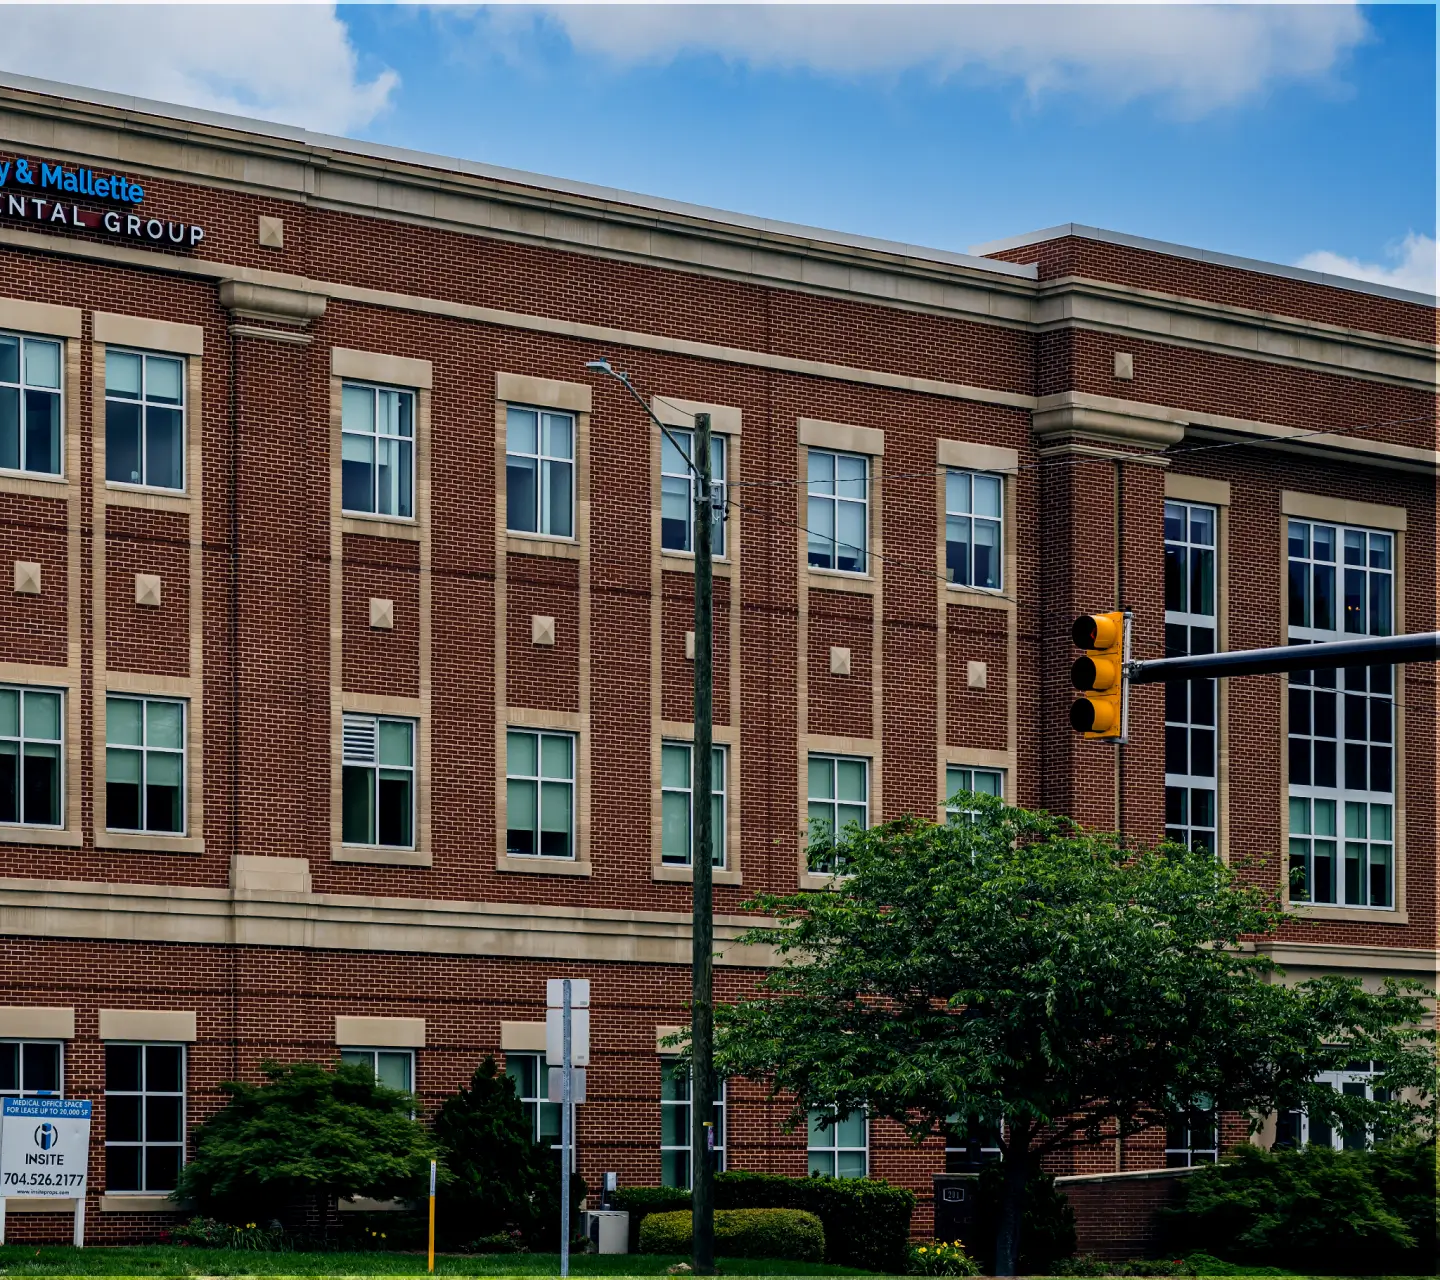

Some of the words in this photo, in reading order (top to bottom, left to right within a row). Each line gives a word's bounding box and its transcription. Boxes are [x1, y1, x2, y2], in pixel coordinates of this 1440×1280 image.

[15, 158, 34, 186] &
[41, 162, 144, 204] Mallette
[103, 211, 204, 246] GROUP
[12, 1099, 40, 1107] MEDICAL
[41, 1100, 63, 1108] OFFICE
[59, 1108, 80, 1116] 20,000
[25, 1153, 64, 1166] INSITE
[3, 1172, 85, 1187] 704.526.2177
